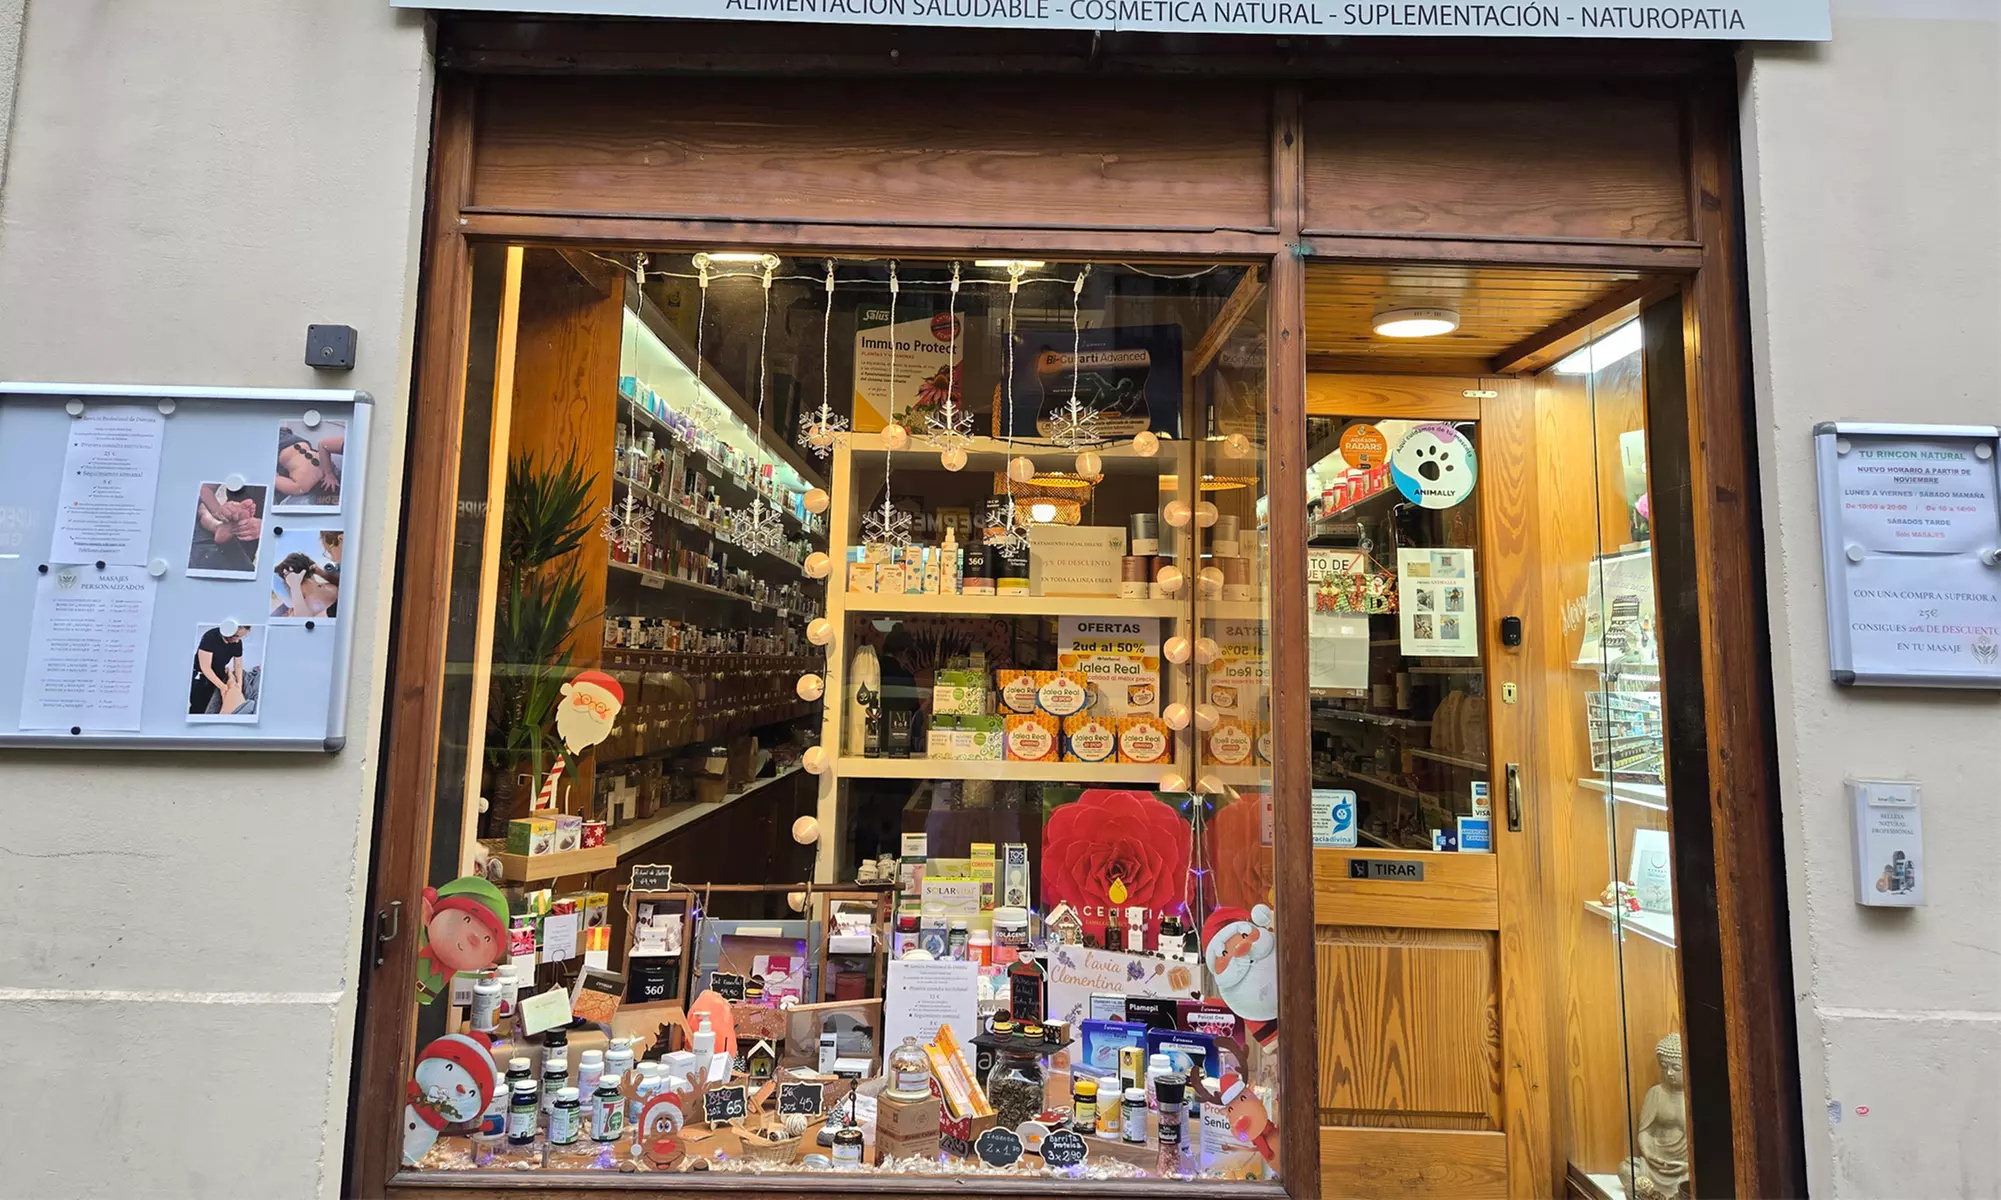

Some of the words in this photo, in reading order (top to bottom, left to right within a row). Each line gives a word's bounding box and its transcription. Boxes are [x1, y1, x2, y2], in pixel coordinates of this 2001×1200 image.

[913, 0, 1049, 19] SALUDABLE
[1070, 0, 1207, 22] COSMETICA
[1214, 1, 1323, 25] NATURAL
[1344, 2, 1561, 28] SUPLEMENTACIÓN
[1582, 8, 1745, 30] NATUROPATIA
[863, 309, 890, 321] Salus
[861, 336, 910, 351] Immuno
[914, 340, 957, 354] Protect
[1046, 353, 1098, 365] Bi-Cuarti
[1100, 352, 1146, 362] Advanced
[1345, 442, 1382, 450] RADARS
[1396, 439, 1407, 454] Aquí
[1406, 426, 1435, 440] cuidamos
[1454, 433, 1472, 458] mascota
[1876, 450, 1918, 458] RINCON
[1921, 452, 1966, 460] NATURAL
[1332, 560, 1350, 570] DE
[1877, 590, 1898, 599] UNA
[1900, 591, 1942, 600] COMPRA
[1944, 592, 1991, 602] SUPERIOR
[1991, 594, 1998, 602] A
[1919, 608, 1938, 620] 25€
[1078, 622, 1140, 634] OFERTAS
[1852, 622, 1907, 632] CONSIGUES
[1908, 625, 1924, 633] 20%
[1926, 625, 1940, 634] DE
[1073, 642, 1096, 652] 2ud
[1101, 642, 1112, 652] al
[1117, 642, 1145, 654] 50%
[1897, 642, 1909, 650] EN
[1912, 643, 1924, 652] TU
[1926, 644, 1962, 654] MASAJE
[1077, 662, 1110, 673] Jalea
[1114, 663, 1140, 674] Real
[1012, 733, 1030, 741] Jalea
[1074, 734, 1094, 742] Jalea
[1124, 734, 1144, 742] Jalea
[1375, 863, 1416, 876] TIRAR
[1050, 965, 1124, 992] Clementina
[1129, 1004, 1159, 1012] Plamepil
[726, 1100, 742, 1115] 65
[799, 1096, 814, 1112] 45
[1204, 1115, 1230, 1130] Senio
